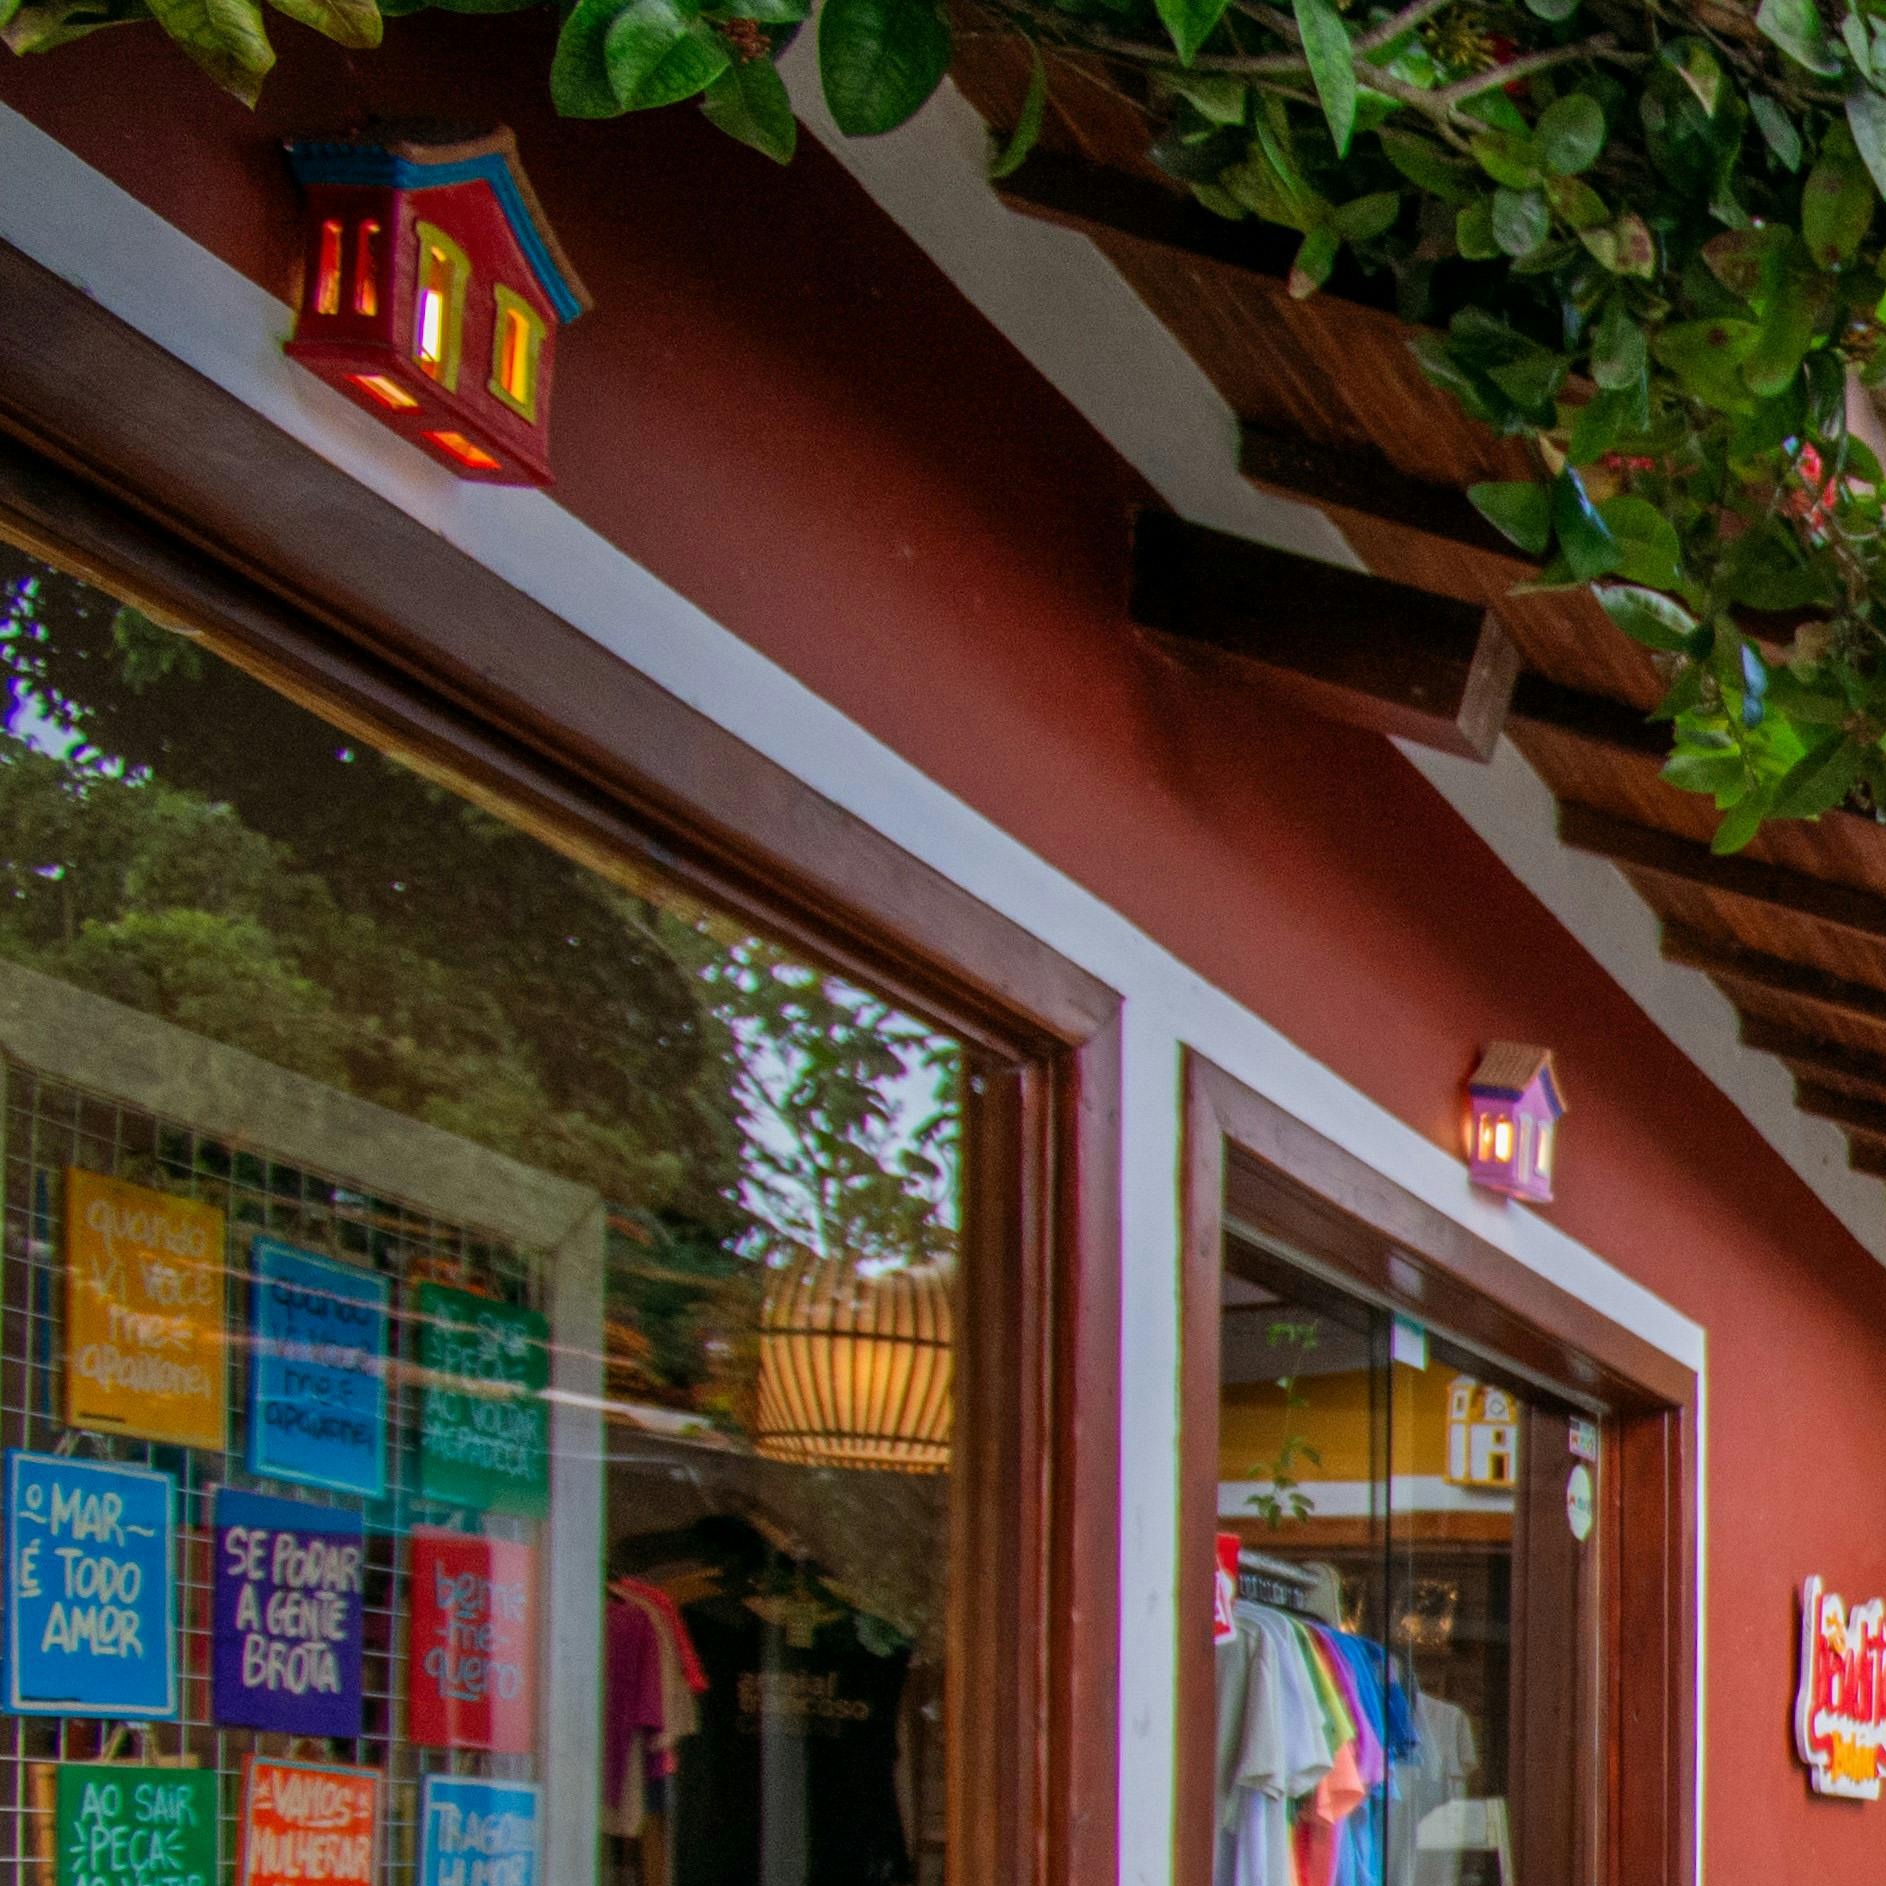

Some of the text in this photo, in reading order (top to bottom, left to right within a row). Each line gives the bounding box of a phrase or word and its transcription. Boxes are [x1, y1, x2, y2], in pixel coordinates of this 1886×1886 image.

[51, 1481, 126, 1547] MAR
[54, 1546, 142, 1605] TODO
[224, 1525, 363, 1594] SE PODAR
[41, 1601, 144, 1659] AMOR
[234, 1582, 348, 1643] A GENTE
[241, 1633, 342, 1695] BROTA
[81, 1781, 198, 1827] AO SAIR
[270, 1767, 353, 1828] VAMOS
[90, 1824, 166, 1878] PEÇA
[249, 1825, 372, 1882] MULHERAR
